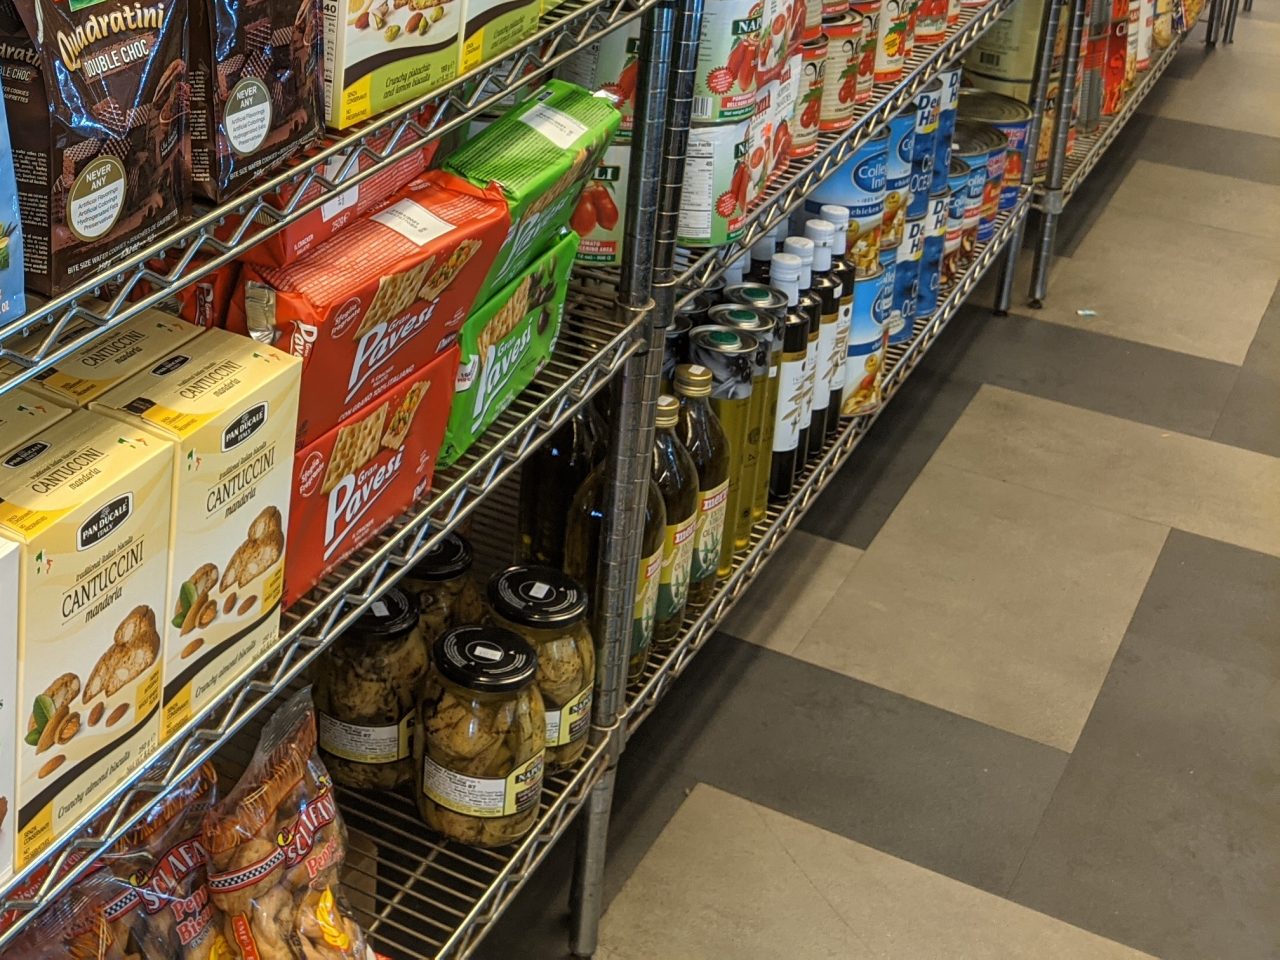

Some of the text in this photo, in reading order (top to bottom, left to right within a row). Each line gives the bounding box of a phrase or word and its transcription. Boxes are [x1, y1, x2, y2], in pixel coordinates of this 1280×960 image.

[56, 3, 165, 73] Quadratini
[83, 39, 150, 78] DOUBLE CHOC
[236, 85, 257, 100] NEVER
[86, 164, 111, 183] NEVER
[91, 178, 108, 192] ANY
[858, 165, 887, 178] Colle
[82, 329, 146, 367] CANTUCCINI
[348, 298, 439, 390] Pavesi
[178, 361, 242, 400] CANTUCCINI
[31, 448, 105, 494] CANTUCCINI
[206, 446, 276, 512] CANTUCCINI
[324, 444, 405, 543] Pavesi
[62, 540, 144, 619] CANTUCCINI
[145, 840, 207, 913] SCLAFA
